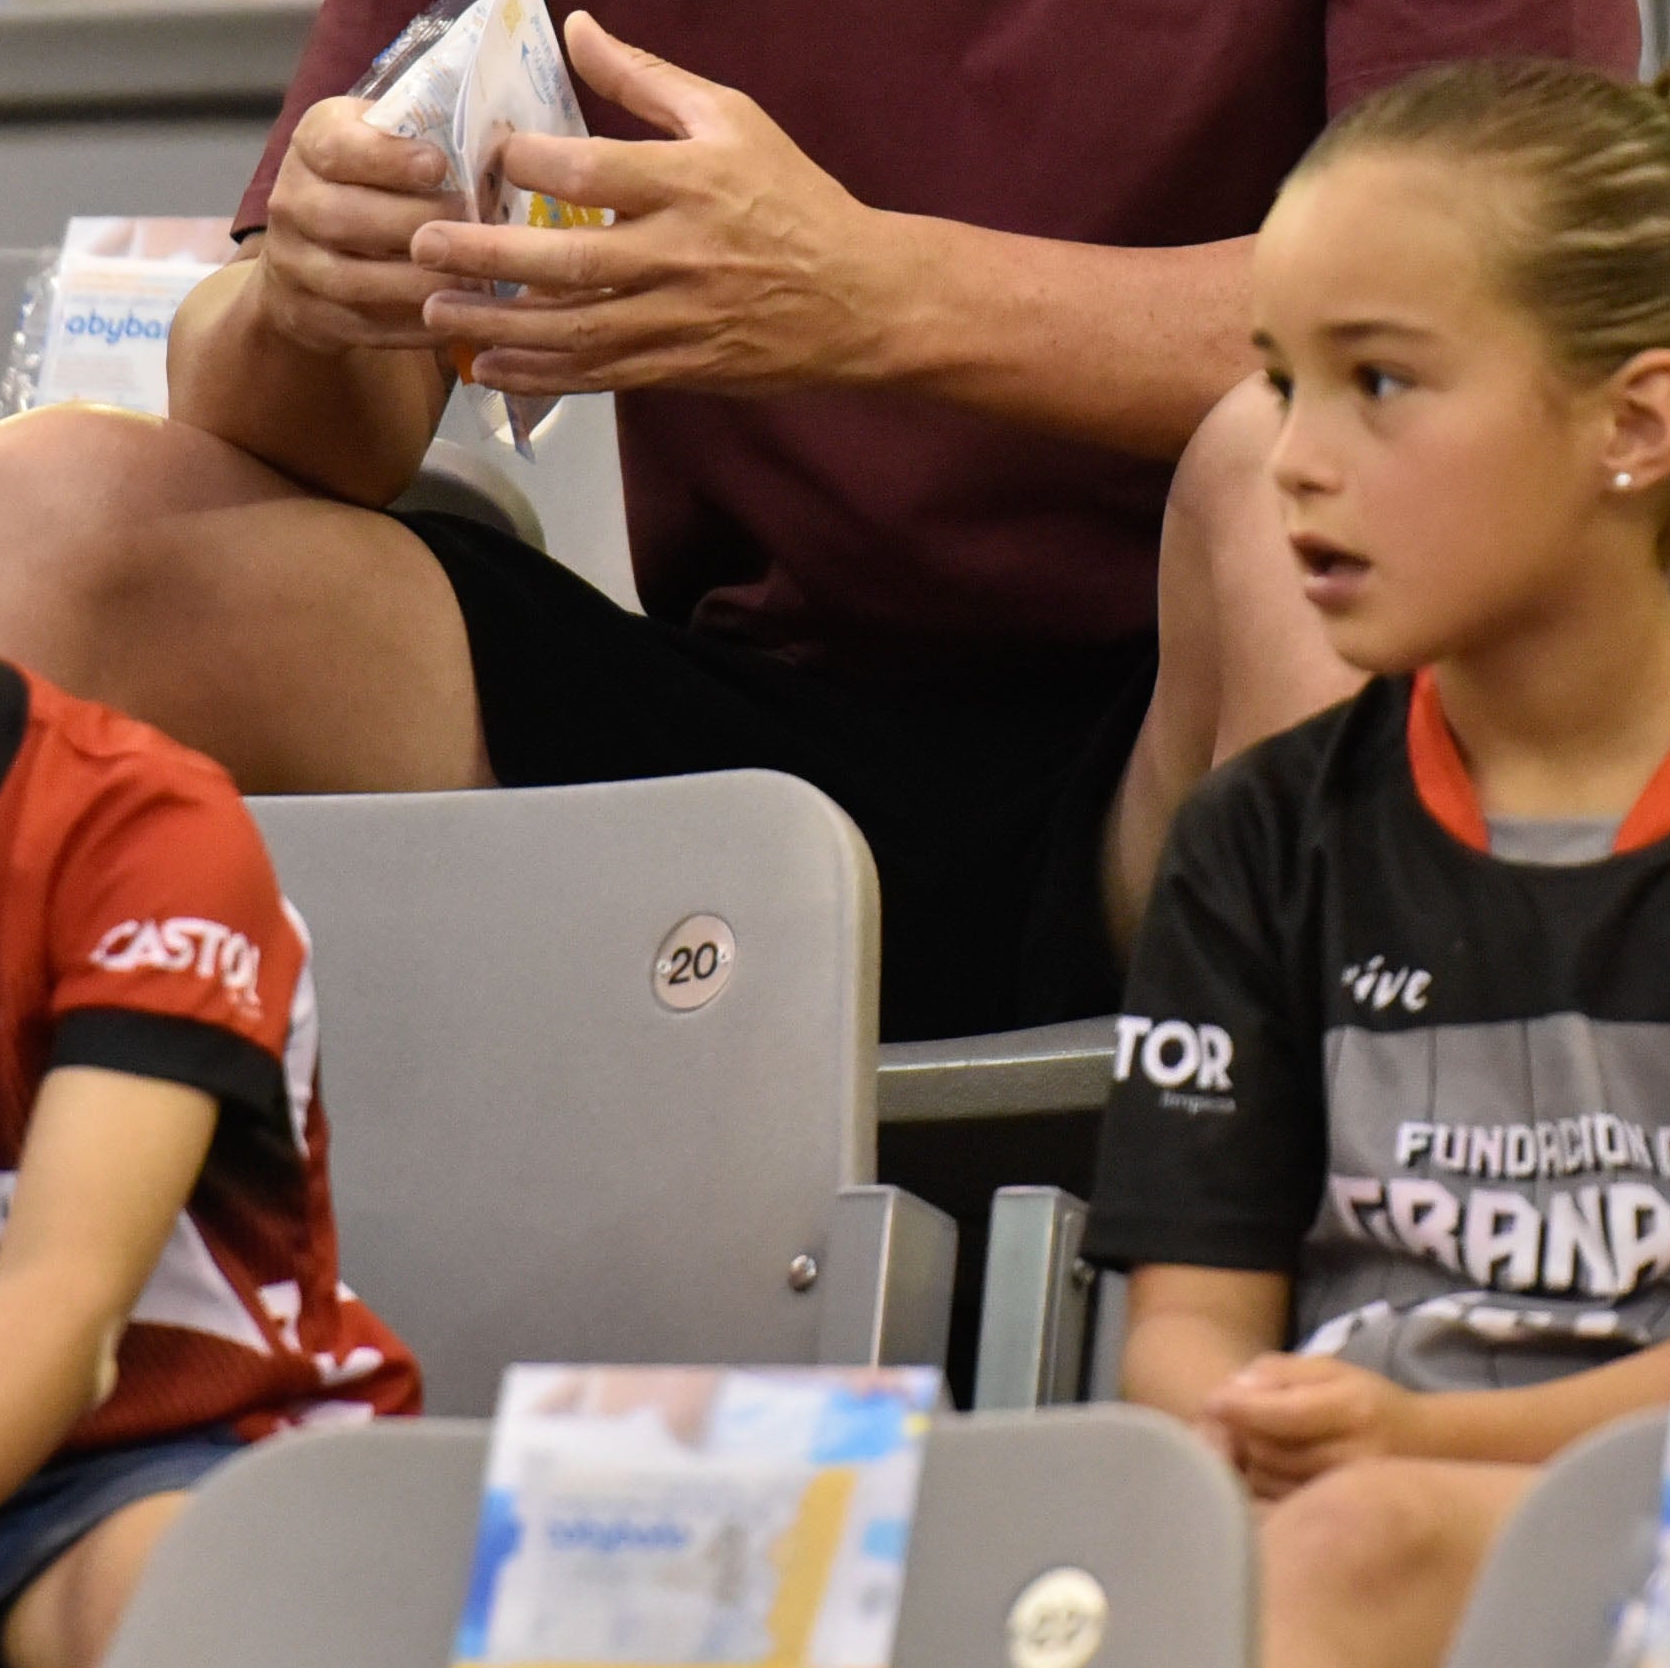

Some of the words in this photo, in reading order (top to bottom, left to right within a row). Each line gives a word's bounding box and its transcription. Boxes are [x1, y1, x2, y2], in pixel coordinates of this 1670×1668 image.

[66, 307, 170, 345] abyba
[668, 941, 718, 985] 20
[1114, 1014, 1234, 1090] TOR
